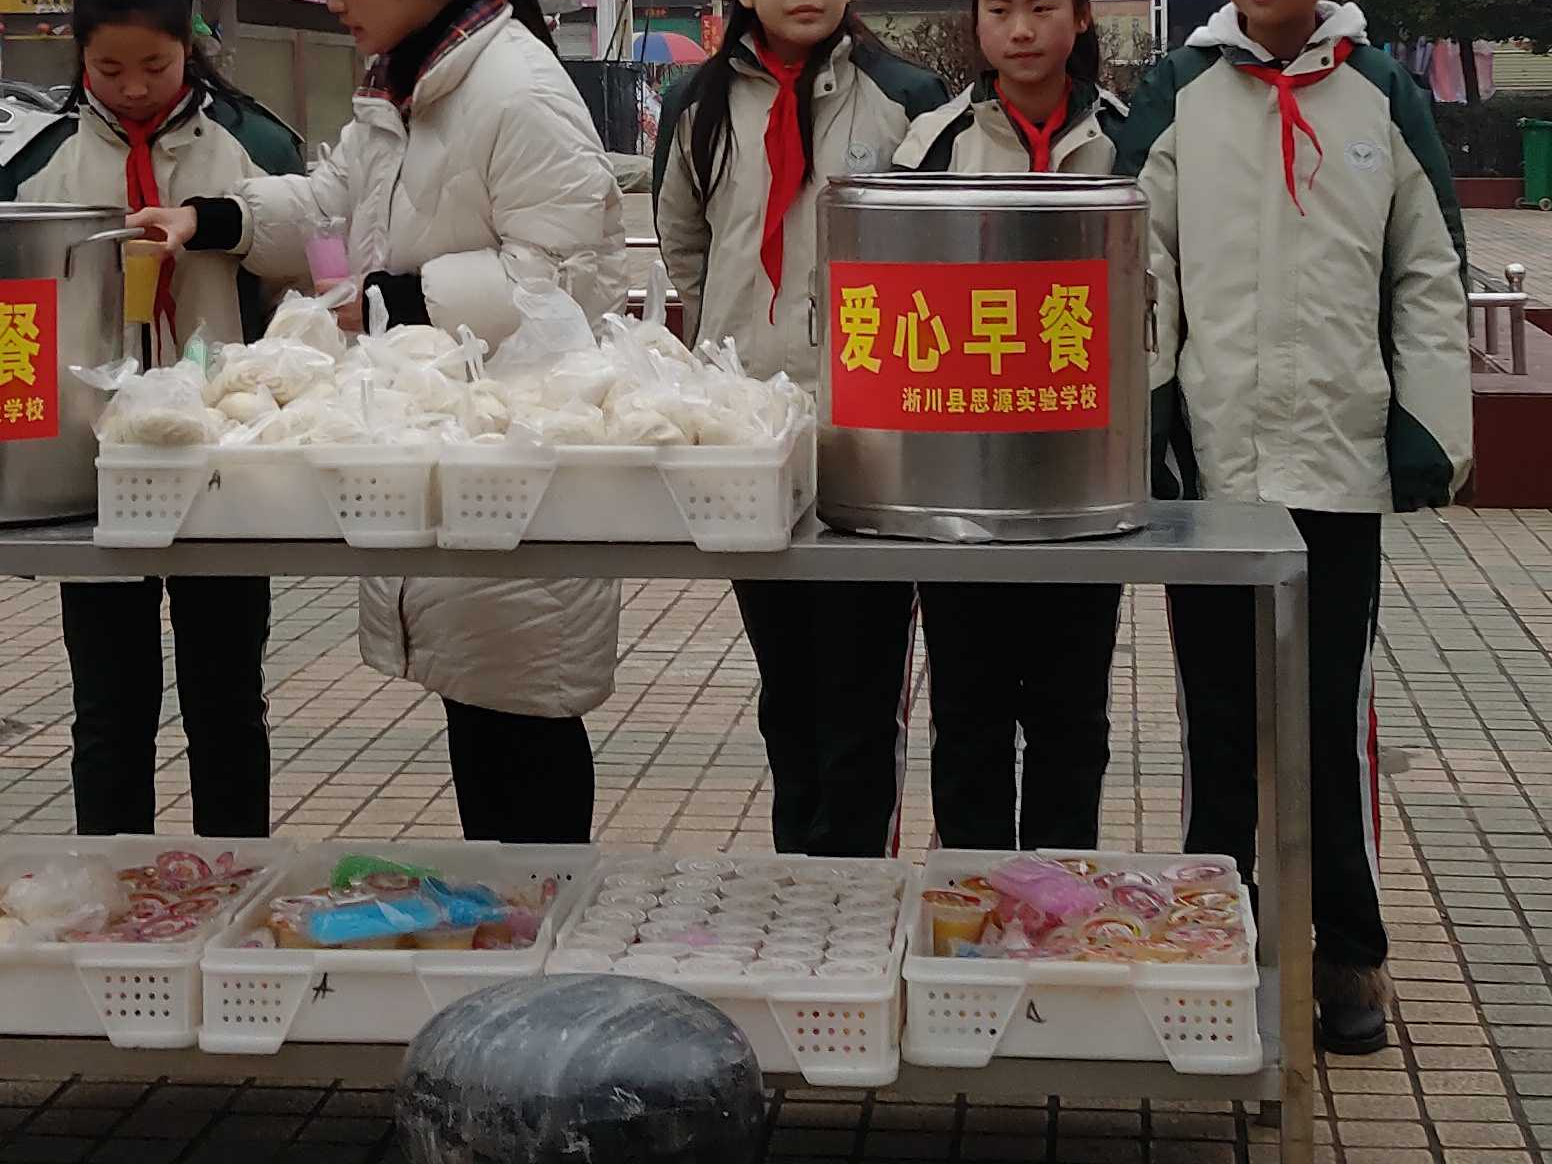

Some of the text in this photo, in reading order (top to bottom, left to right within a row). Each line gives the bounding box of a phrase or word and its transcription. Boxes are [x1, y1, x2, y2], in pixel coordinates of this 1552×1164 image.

[839, 283, 1094, 376] 爱心早餐
[901, 383, 1098, 414] 淅川县思源实验学校
